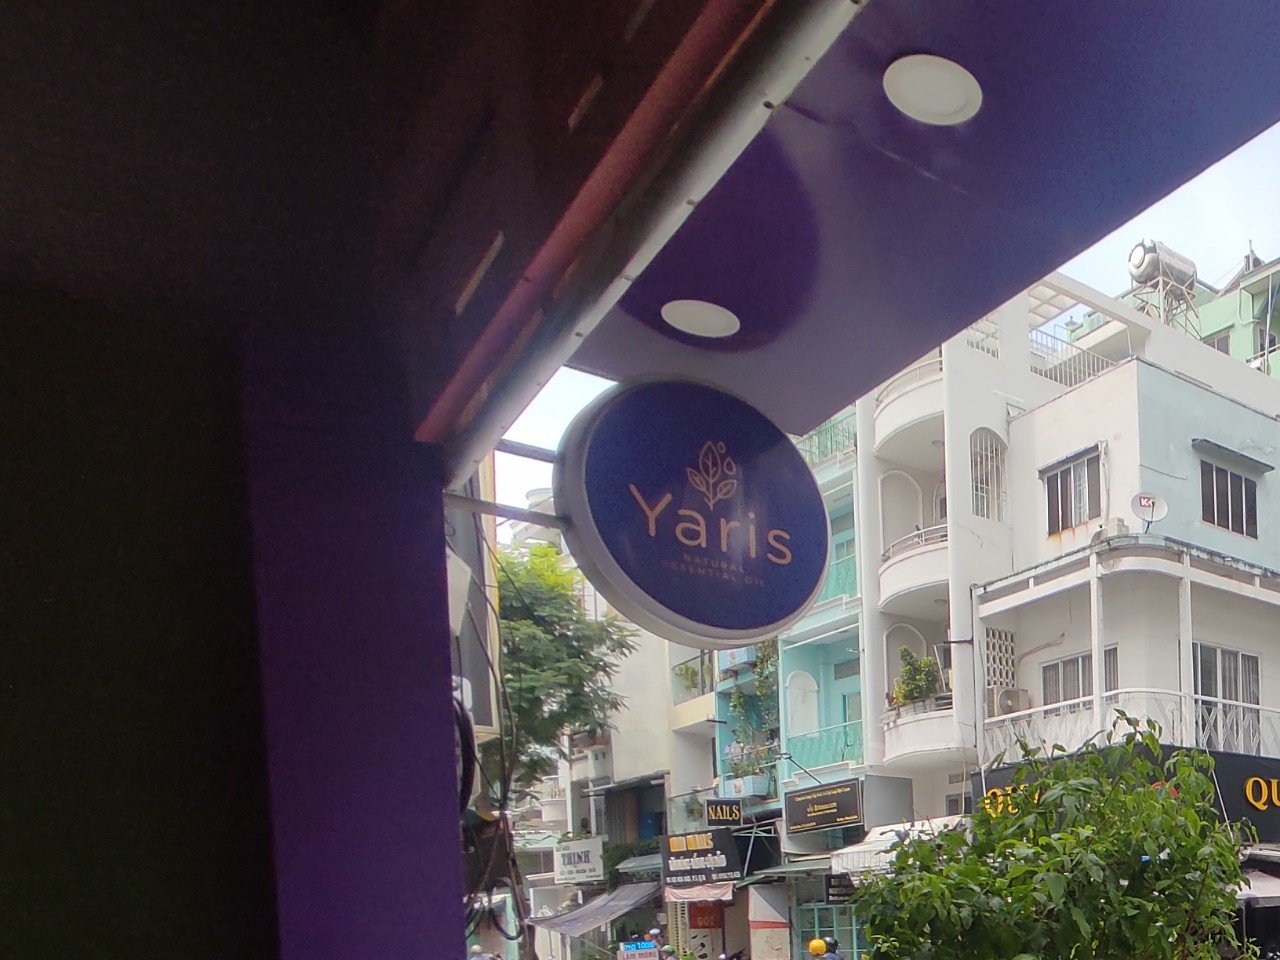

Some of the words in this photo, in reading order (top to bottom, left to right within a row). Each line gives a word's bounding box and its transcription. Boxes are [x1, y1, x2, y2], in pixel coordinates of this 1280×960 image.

[628, 483, 793, 564] Yaris
[683, 553, 745, 573] NATURAL
[745, 576, 765, 587] OIL
[708, 804, 740, 820] NAILS
